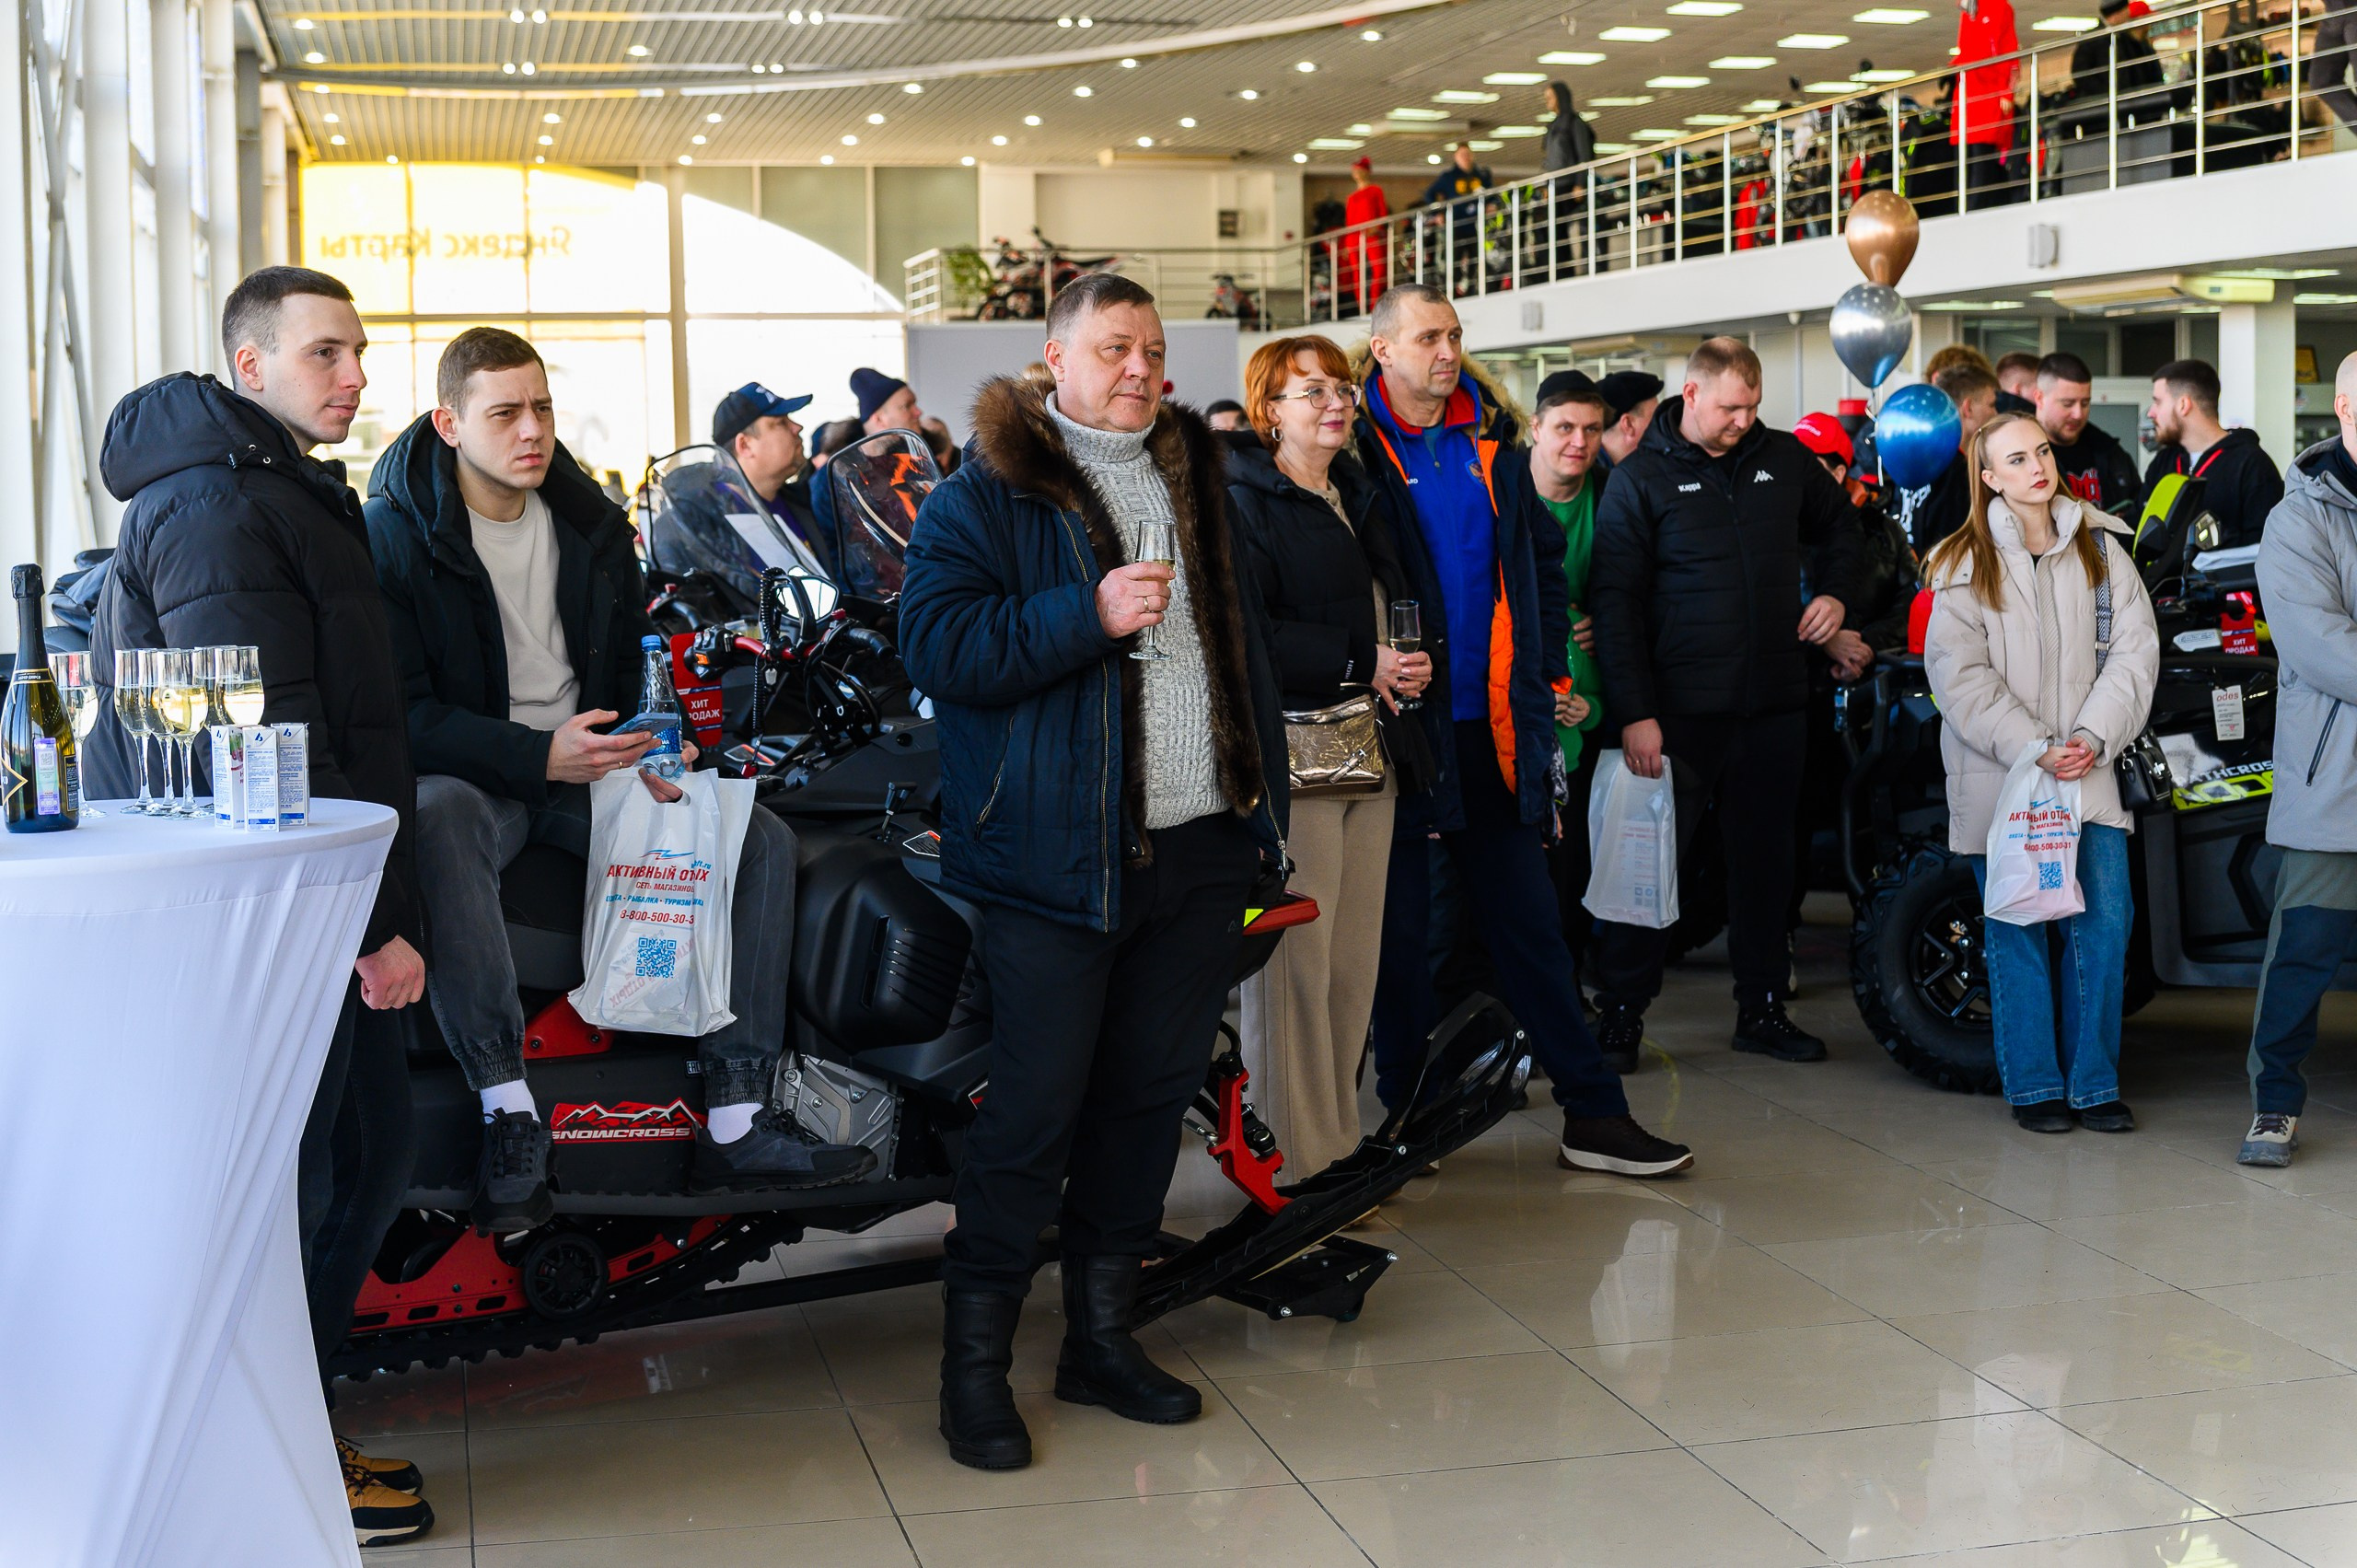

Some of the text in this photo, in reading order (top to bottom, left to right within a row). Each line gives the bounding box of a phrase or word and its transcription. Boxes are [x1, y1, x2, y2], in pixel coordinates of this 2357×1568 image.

[1678, 482, 1701, 493] Kappa
[2225, 645, 2256, 654] ПРОДАЖ
[2217, 692, 2239, 702] odes
[691, 699, 709, 709] ХИТ
[607, 865, 677, 880] АКТИВНЫЙ
[636, 881, 651, 889] СЕТЬ
[627, 895, 658, 904] РЫБАЛКА
[665, 898, 691, 907] ТУРИЗМ
[620, 909, 694, 924] 8-800-500-30-3
[552, 1128, 691, 1140] SNOWCROSS
